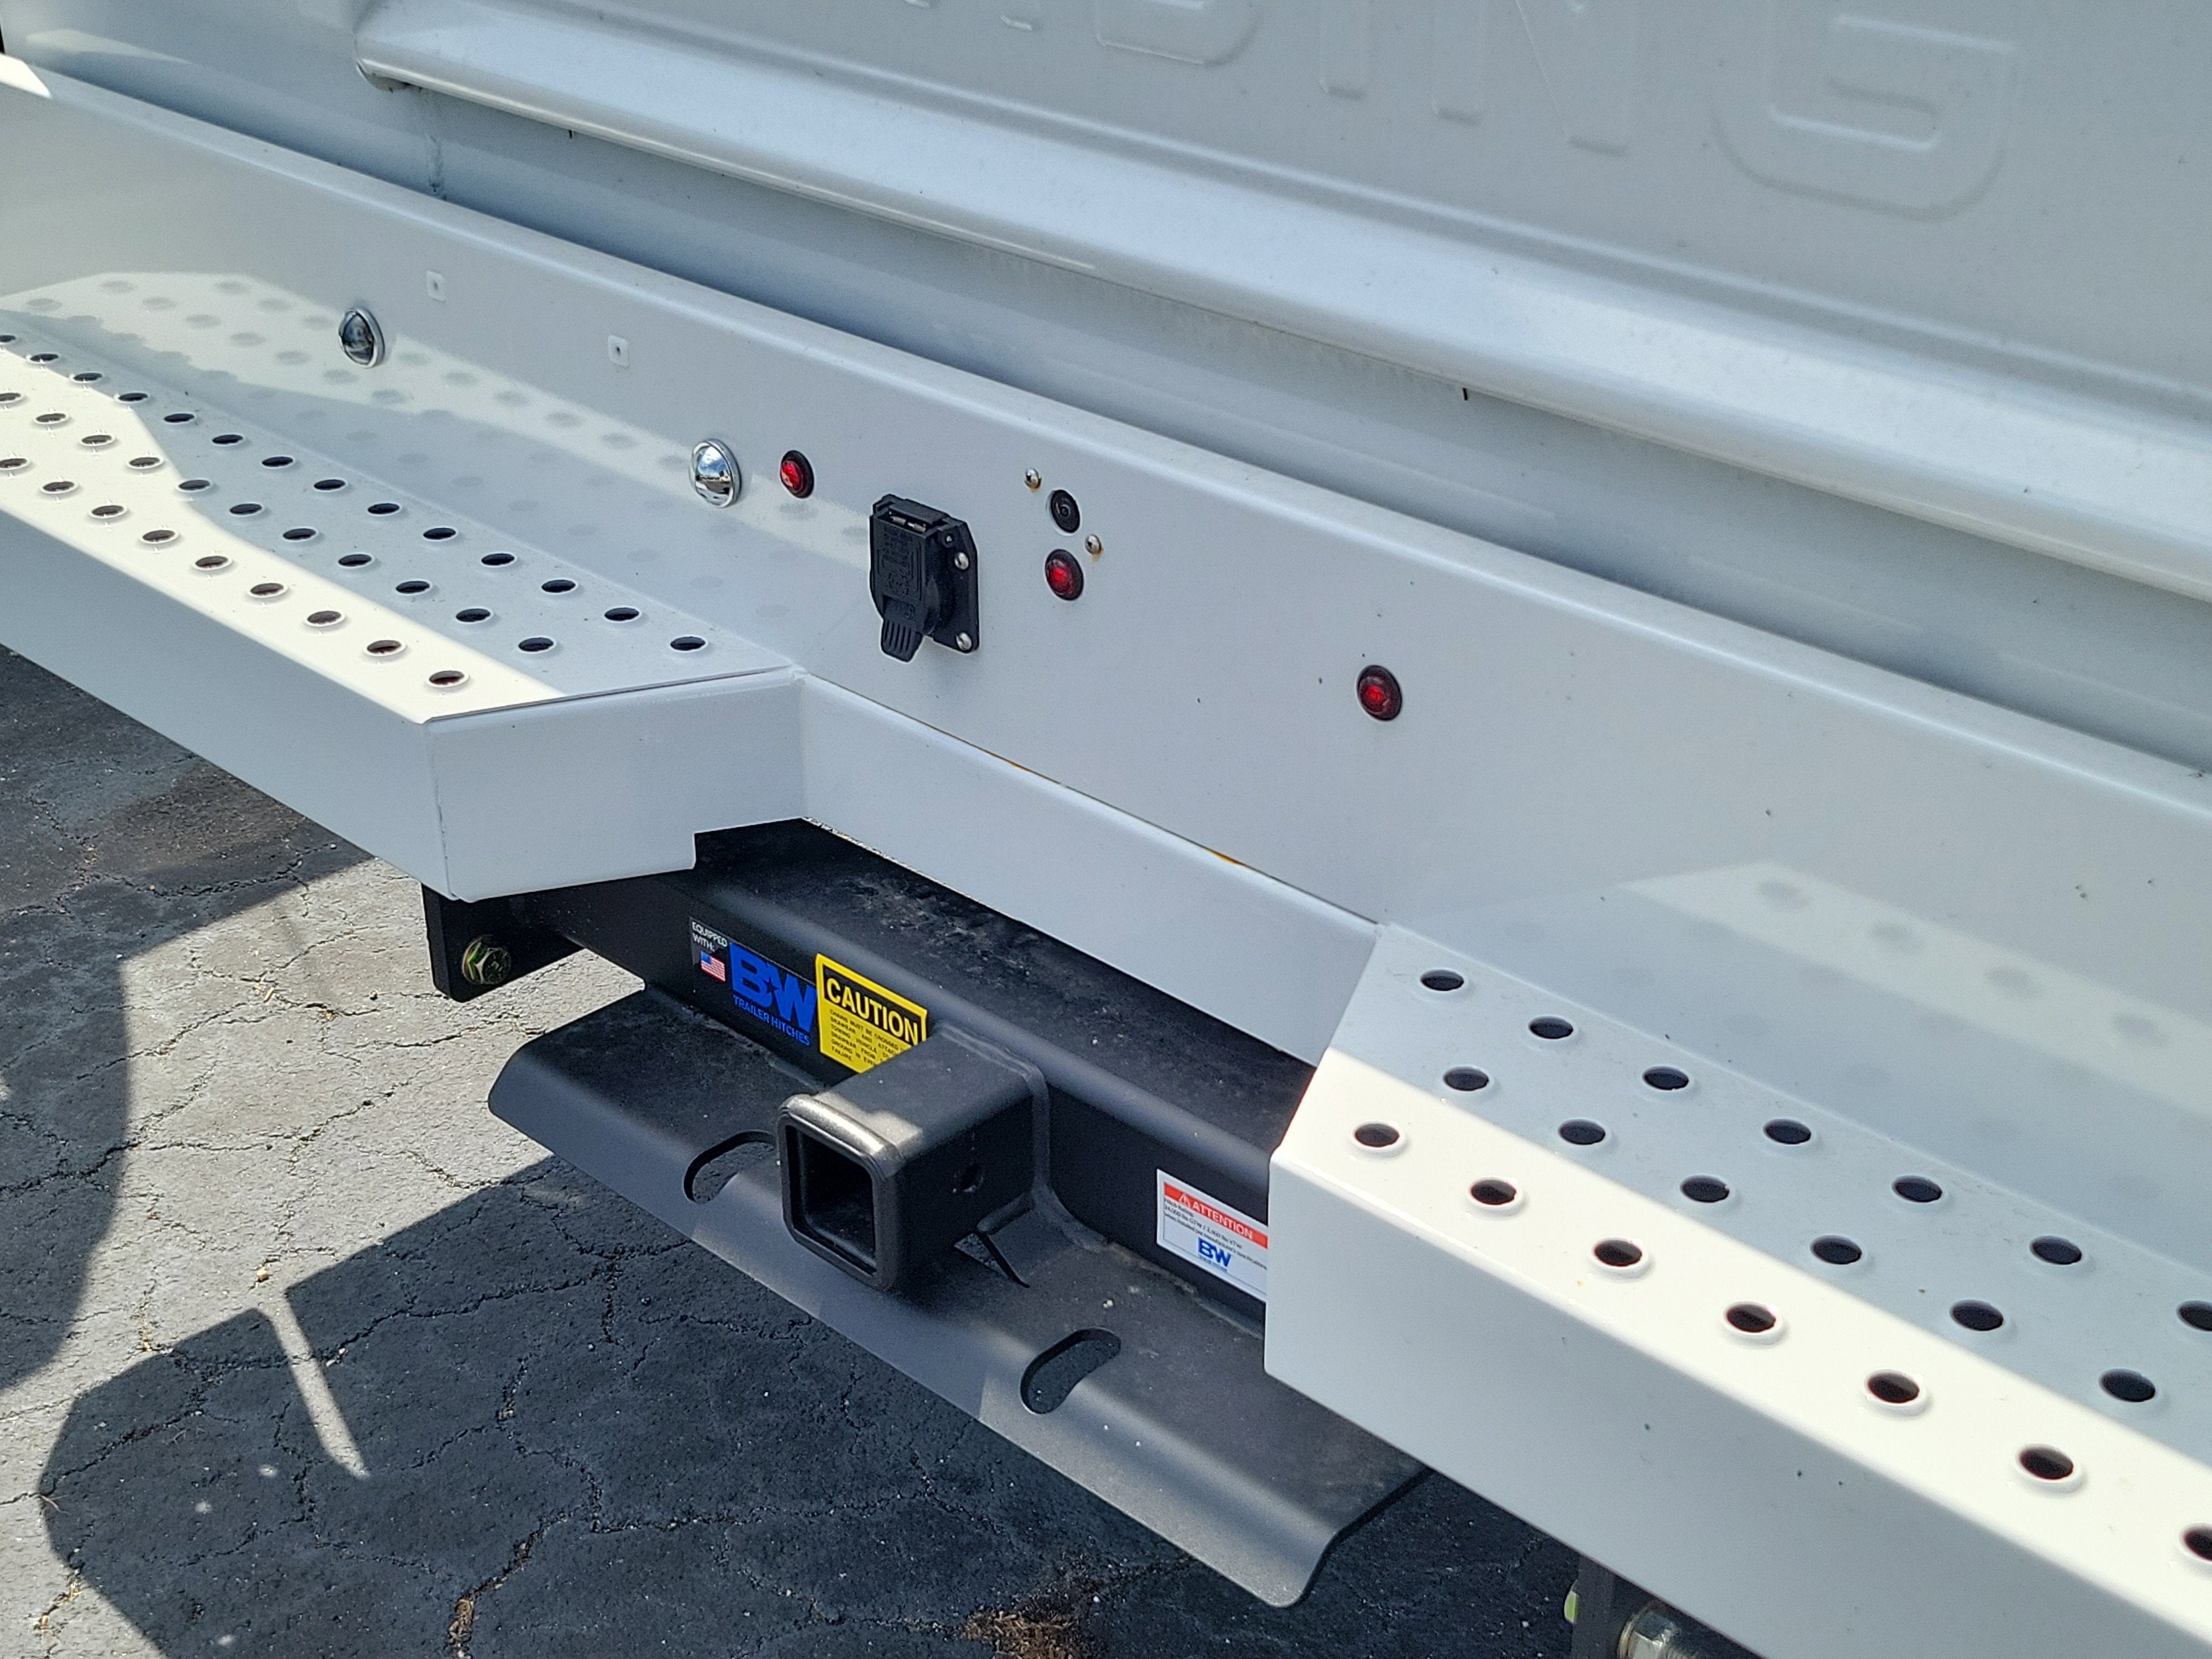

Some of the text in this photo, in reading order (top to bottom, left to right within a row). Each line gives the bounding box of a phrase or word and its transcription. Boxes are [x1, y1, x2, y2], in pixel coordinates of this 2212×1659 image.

[692, 922, 727, 947] EQUIPPED
[692, 933, 715, 952] WITH:
[733, 995, 810, 1046] TRAILER HITCHES
[827, 978, 918, 1046] CAUTION
[878, 1043, 895, 1055] ATTAC
[1192, 1200, 1253, 1240] ATTENTION
